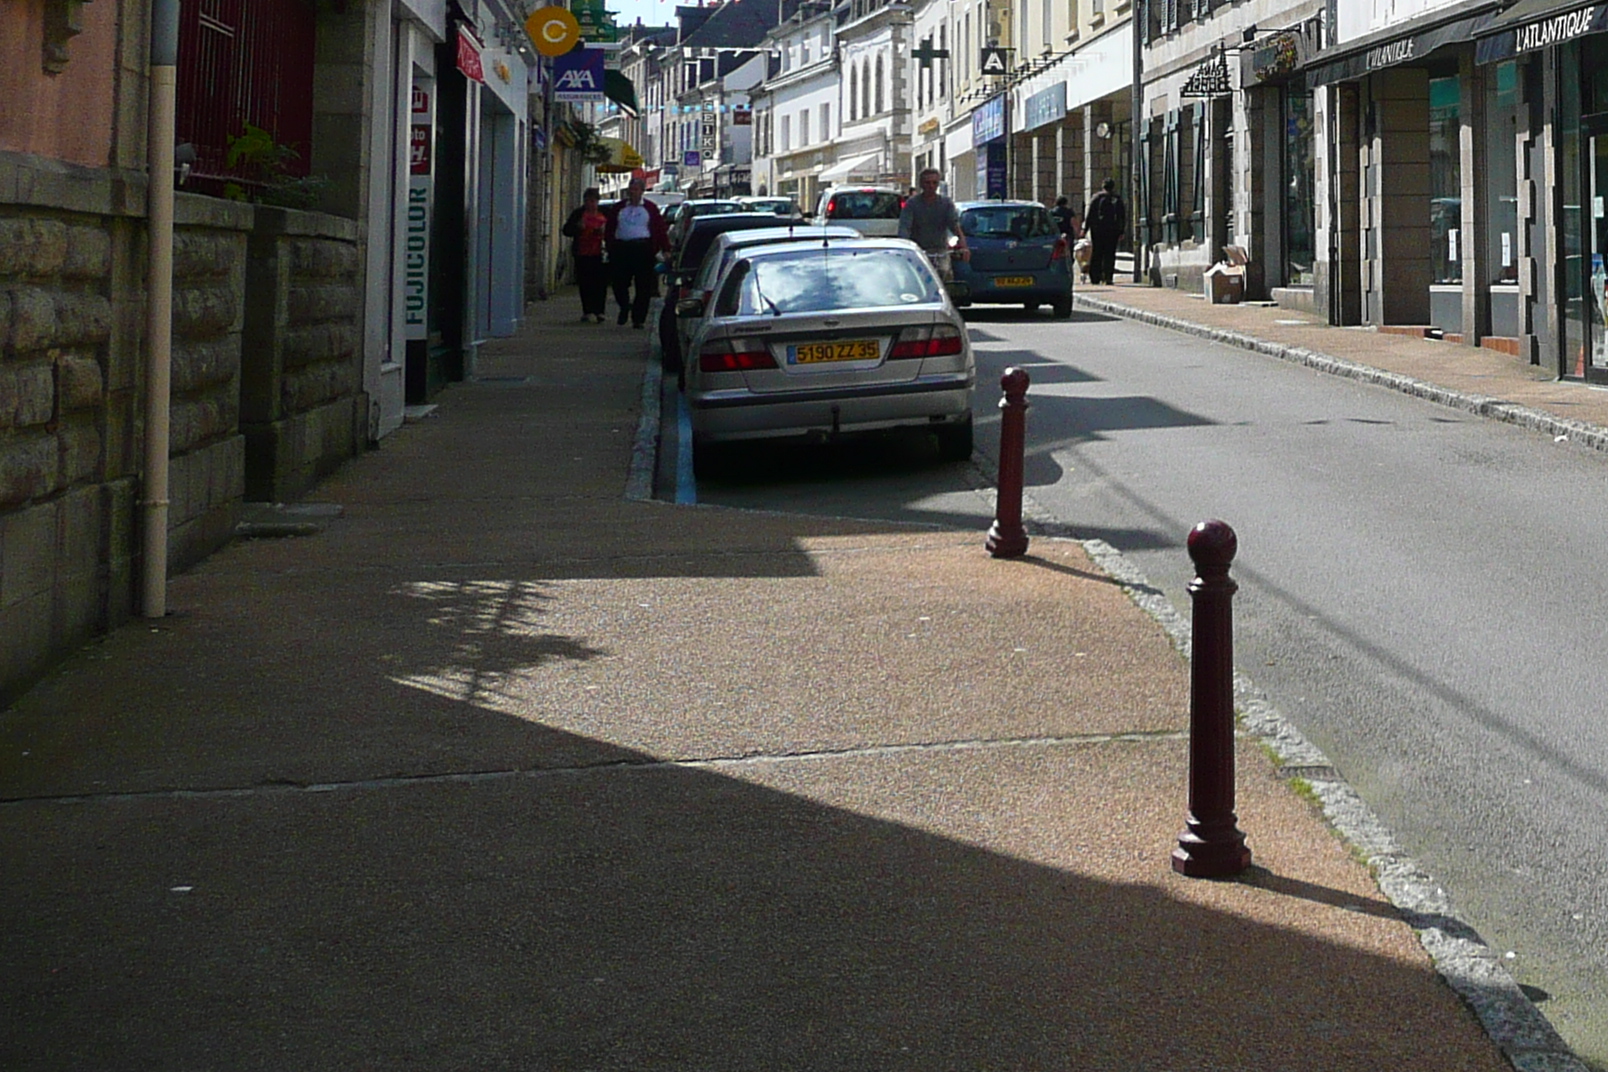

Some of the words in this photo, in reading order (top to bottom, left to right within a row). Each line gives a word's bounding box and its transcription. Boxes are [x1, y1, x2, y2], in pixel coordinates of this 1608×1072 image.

[1516, 6, 1595, 52] L'ATLANTIQUE
[555, 70, 595, 88] AXA
[406, 187, 427, 325] FUJICOLOR
[797, 345, 834, 361] 5190
[837, 344, 855, 358] ZZ
[858, 342, 877, 356] 35
